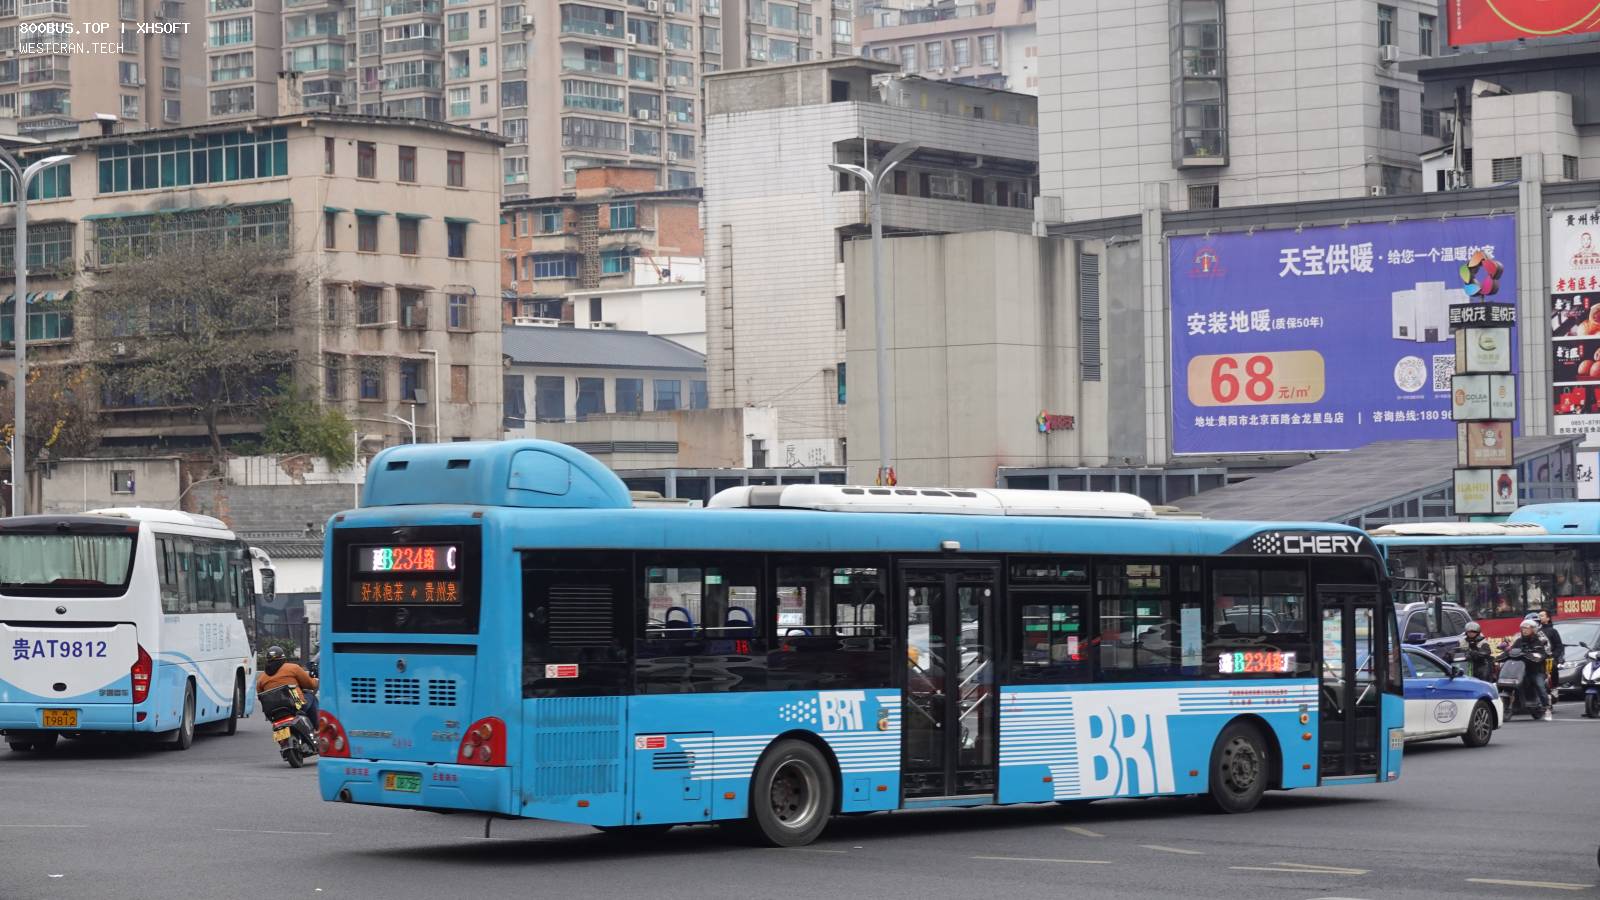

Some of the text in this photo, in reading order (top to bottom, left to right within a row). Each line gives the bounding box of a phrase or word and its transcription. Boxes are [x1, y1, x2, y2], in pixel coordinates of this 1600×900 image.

[1279, 242, 1374, 277] 天宝供暖
[1187, 309, 1324, 336] 安装地暖 (质保50年)
[1450, 307, 1486, 323] 星悦茂
[1211, 355, 1274, 404] 68
[1283, 535, 1364, 553] CHERY
[13, 638, 107, 661] 贵AT9812
[45, 716, 77, 726] T9812
[819, 690, 866, 731] BRT
[1075, 690, 1181, 797] BRT
